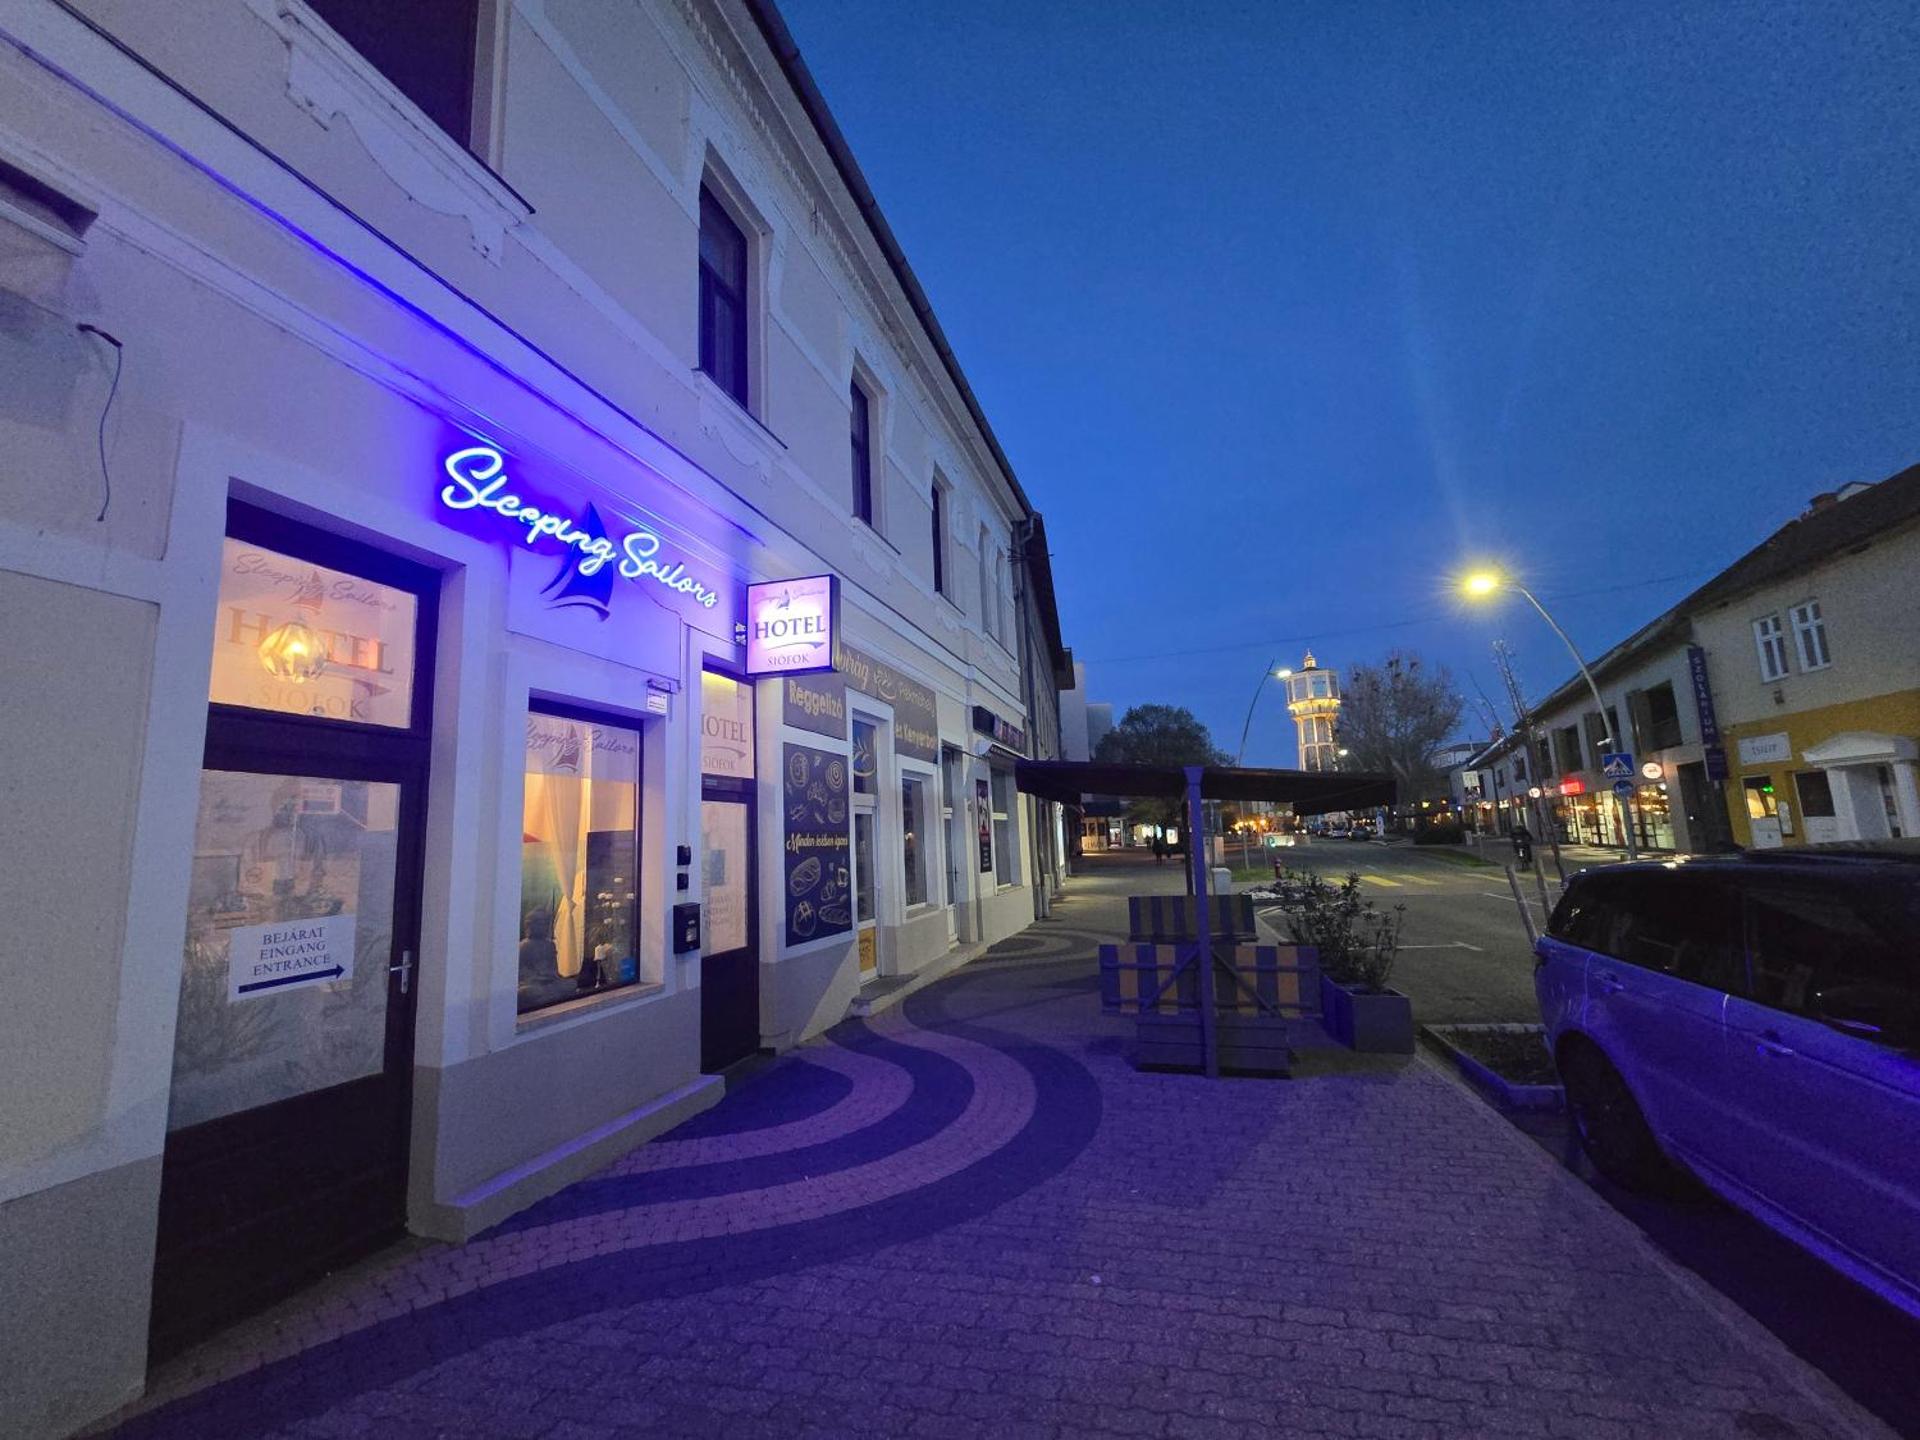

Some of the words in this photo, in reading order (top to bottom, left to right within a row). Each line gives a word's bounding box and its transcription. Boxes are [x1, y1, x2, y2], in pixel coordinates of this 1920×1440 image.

[442, 447, 616, 576] Sleeping
[619, 532, 718, 608] Sailors
[755, 616, 826, 639] HOTEL
[228, 606, 394, 674] HTEL
[263, 927, 326, 946] BEJÁRAT
[260, 940, 326, 960] EINGANG
[254, 953, 331, 976] ENTRANCE
